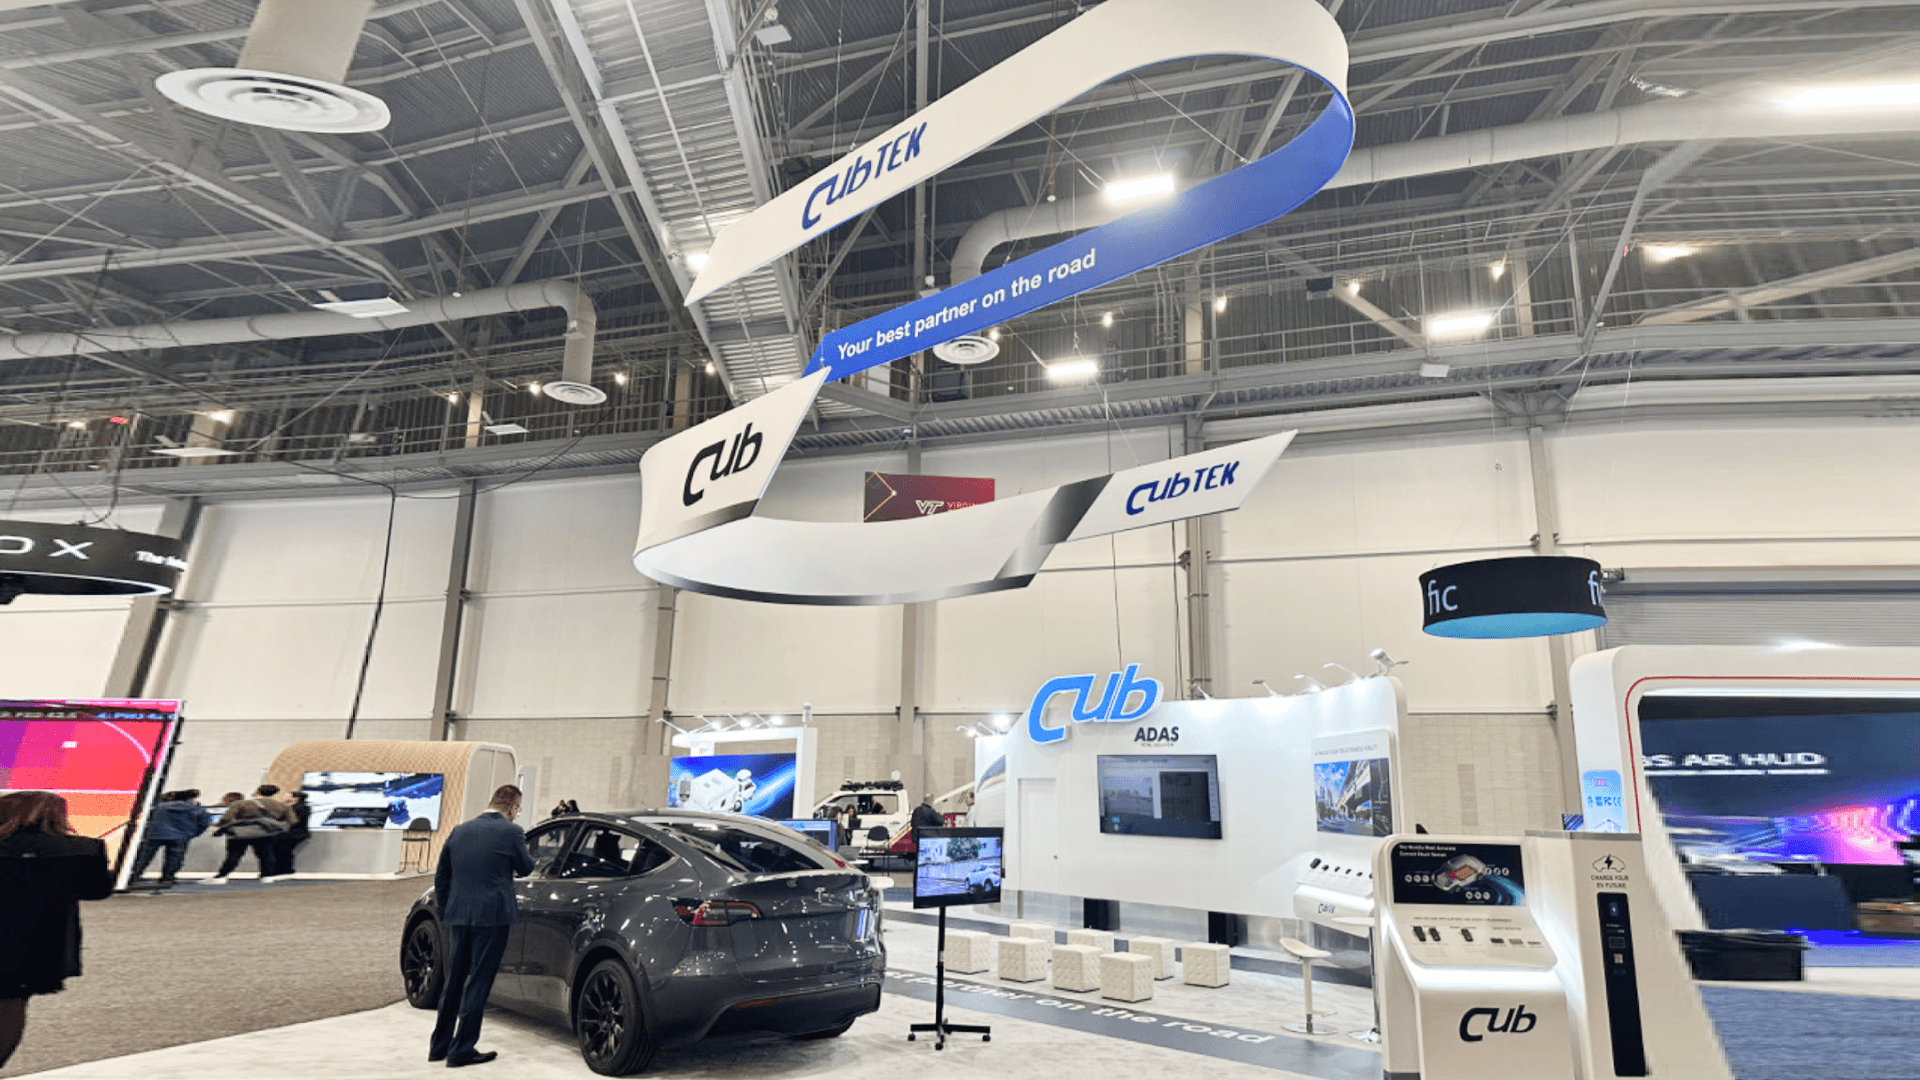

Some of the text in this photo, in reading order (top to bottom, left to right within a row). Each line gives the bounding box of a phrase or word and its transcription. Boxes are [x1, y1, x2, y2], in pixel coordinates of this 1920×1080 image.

[802, 121, 927, 230] CubTEK
[837, 247, 1096, 360] Your best partner on the road
[682, 421, 764, 507] Cub
[1125, 460, 1240, 516] CubTEK
[1427, 579, 1458, 616] fic
[1028, 663, 1164, 744] Cub
[1133, 726, 1179, 743] ADAS
[1682, 753, 1735, 767] AR
[1738, 752, 1828, 767] HUD
[1035, 998, 1086, 1011] on
[1091, 1007, 1159, 1023] the
[1162, 1019, 1277, 1044] road
[1459, 1004, 1538, 1043] Cub
